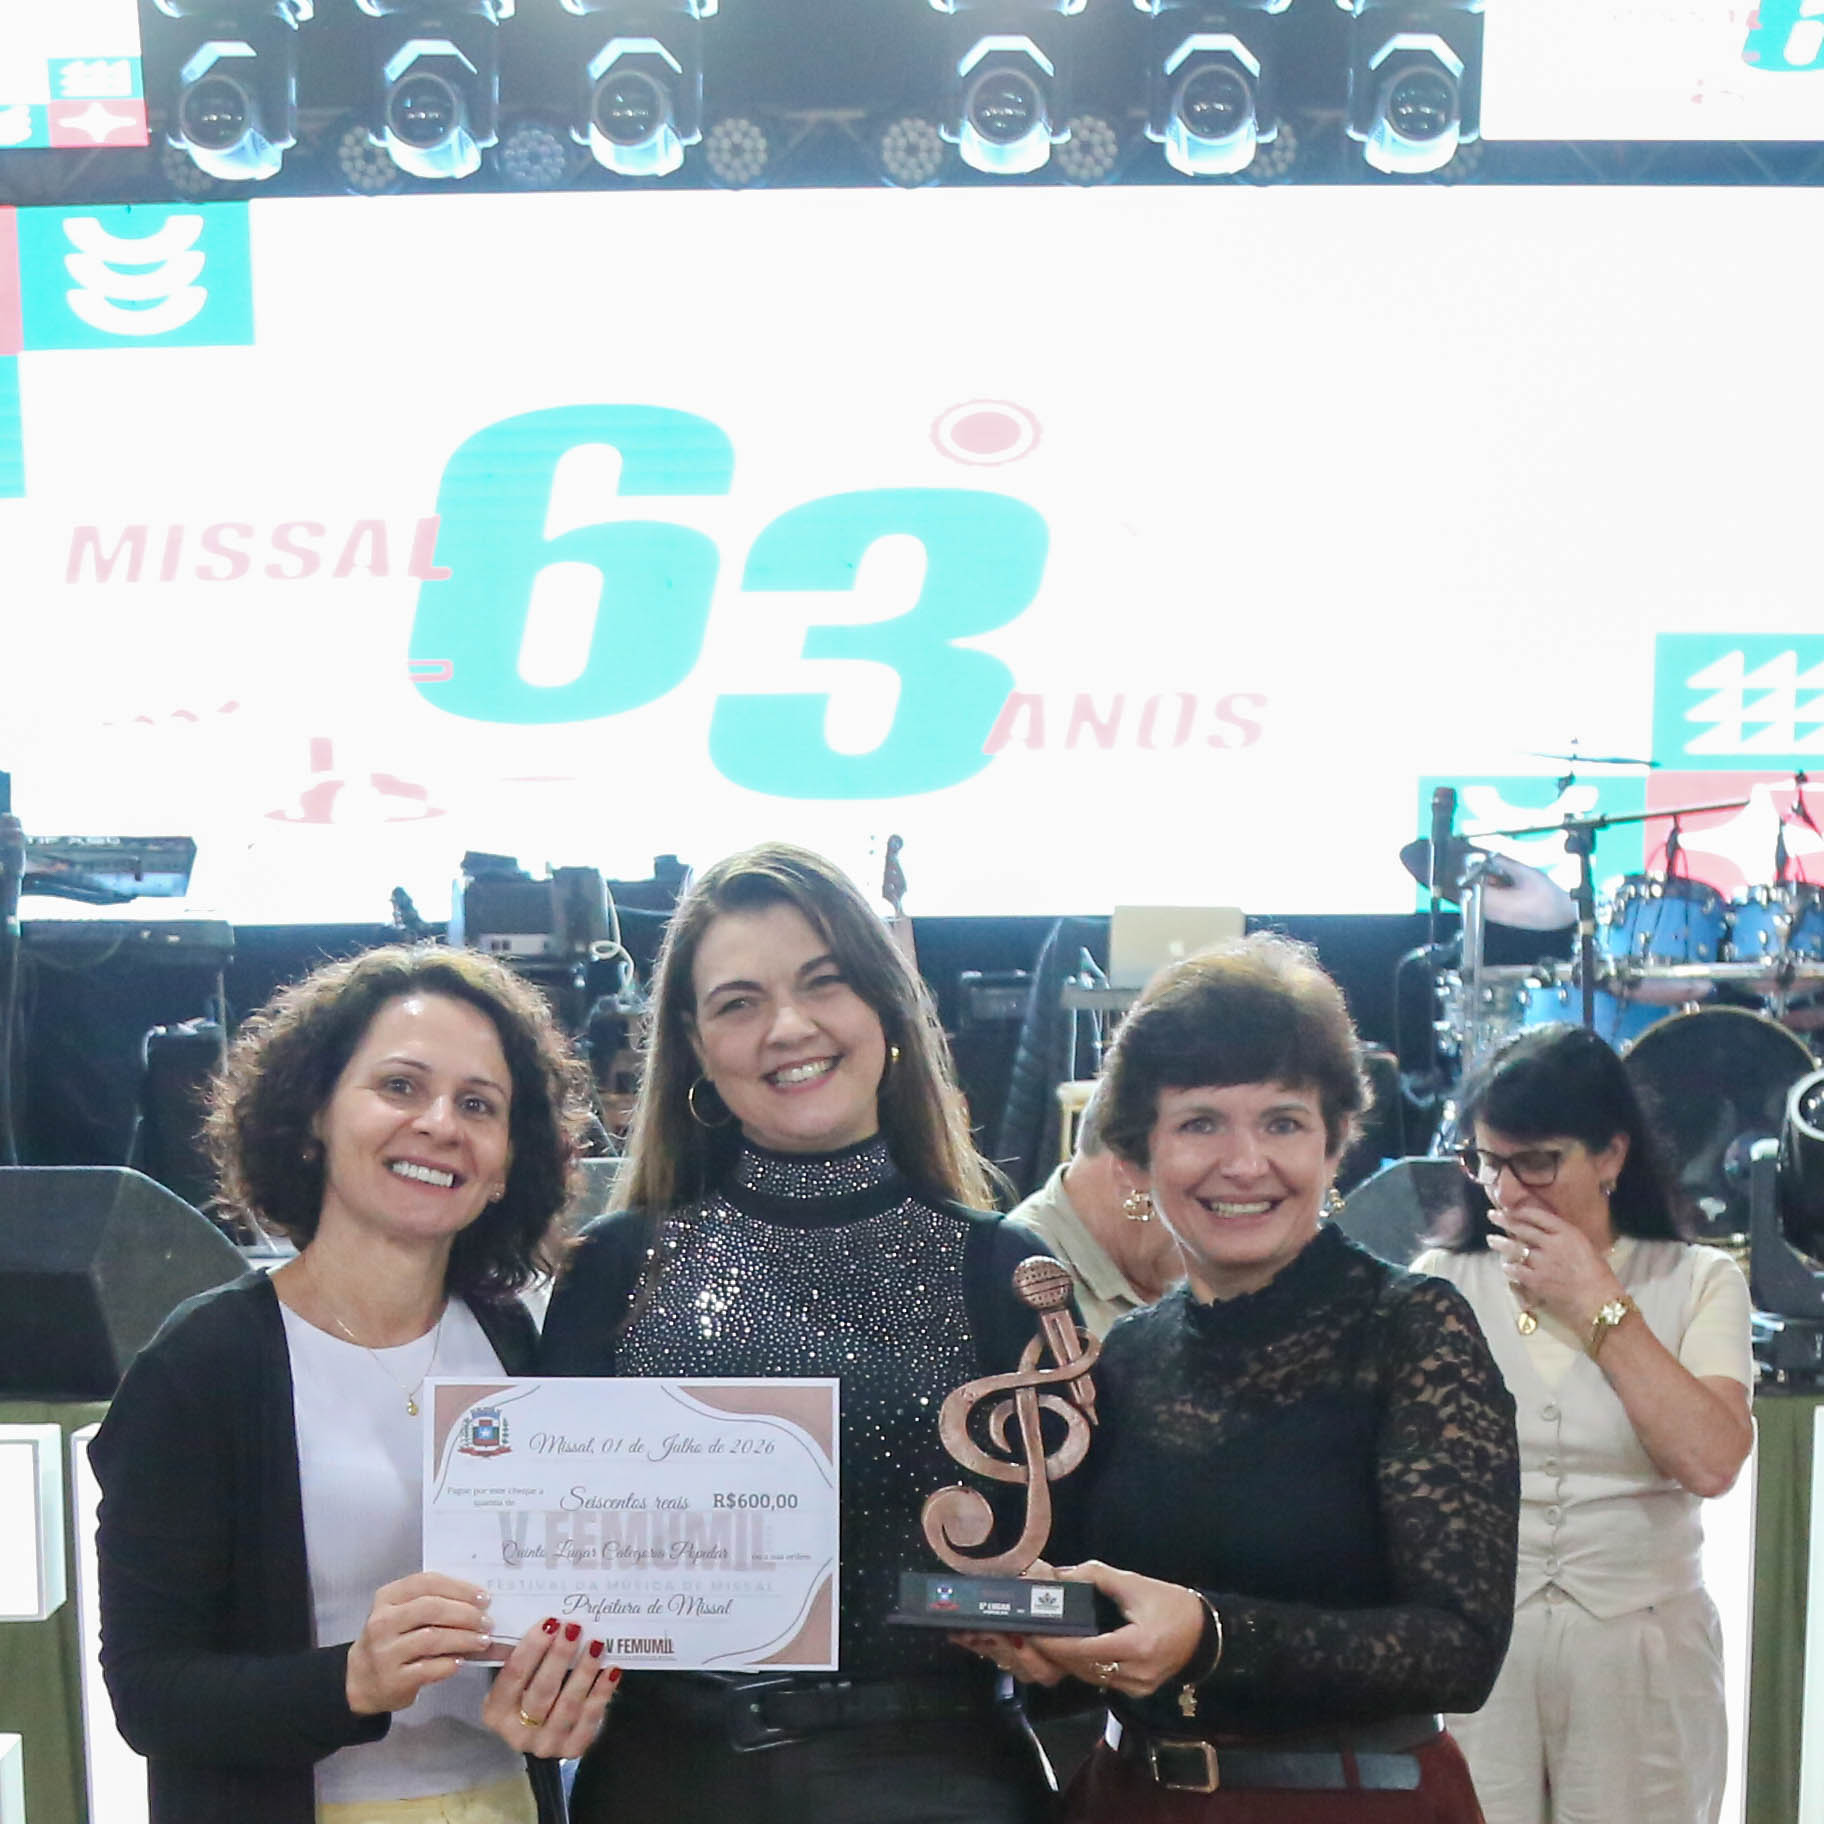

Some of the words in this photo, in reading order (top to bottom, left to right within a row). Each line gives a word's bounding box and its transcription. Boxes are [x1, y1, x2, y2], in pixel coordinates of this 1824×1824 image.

[64, 515, 453, 588] MISSAL
[407, 402, 1051, 801] 63
[982, 689, 1271, 756] ANOS
[628, 1437, 644, 1454] de
[647, 1433, 702, 1462] Julho
[708, 1437, 725, 1454] de
[560, 1486, 648, 1512] Seiscentos
[655, 1495, 690, 1510] reais
[712, 1492, 799, 1511] R$600,00
[562, 1592, 641, 1623] Prefeitura
[647, 1598, 662, 1615] de
[667, 1593, 735, 1617] Missal
[616, 1638, 676, 1655] FEMUMIL
